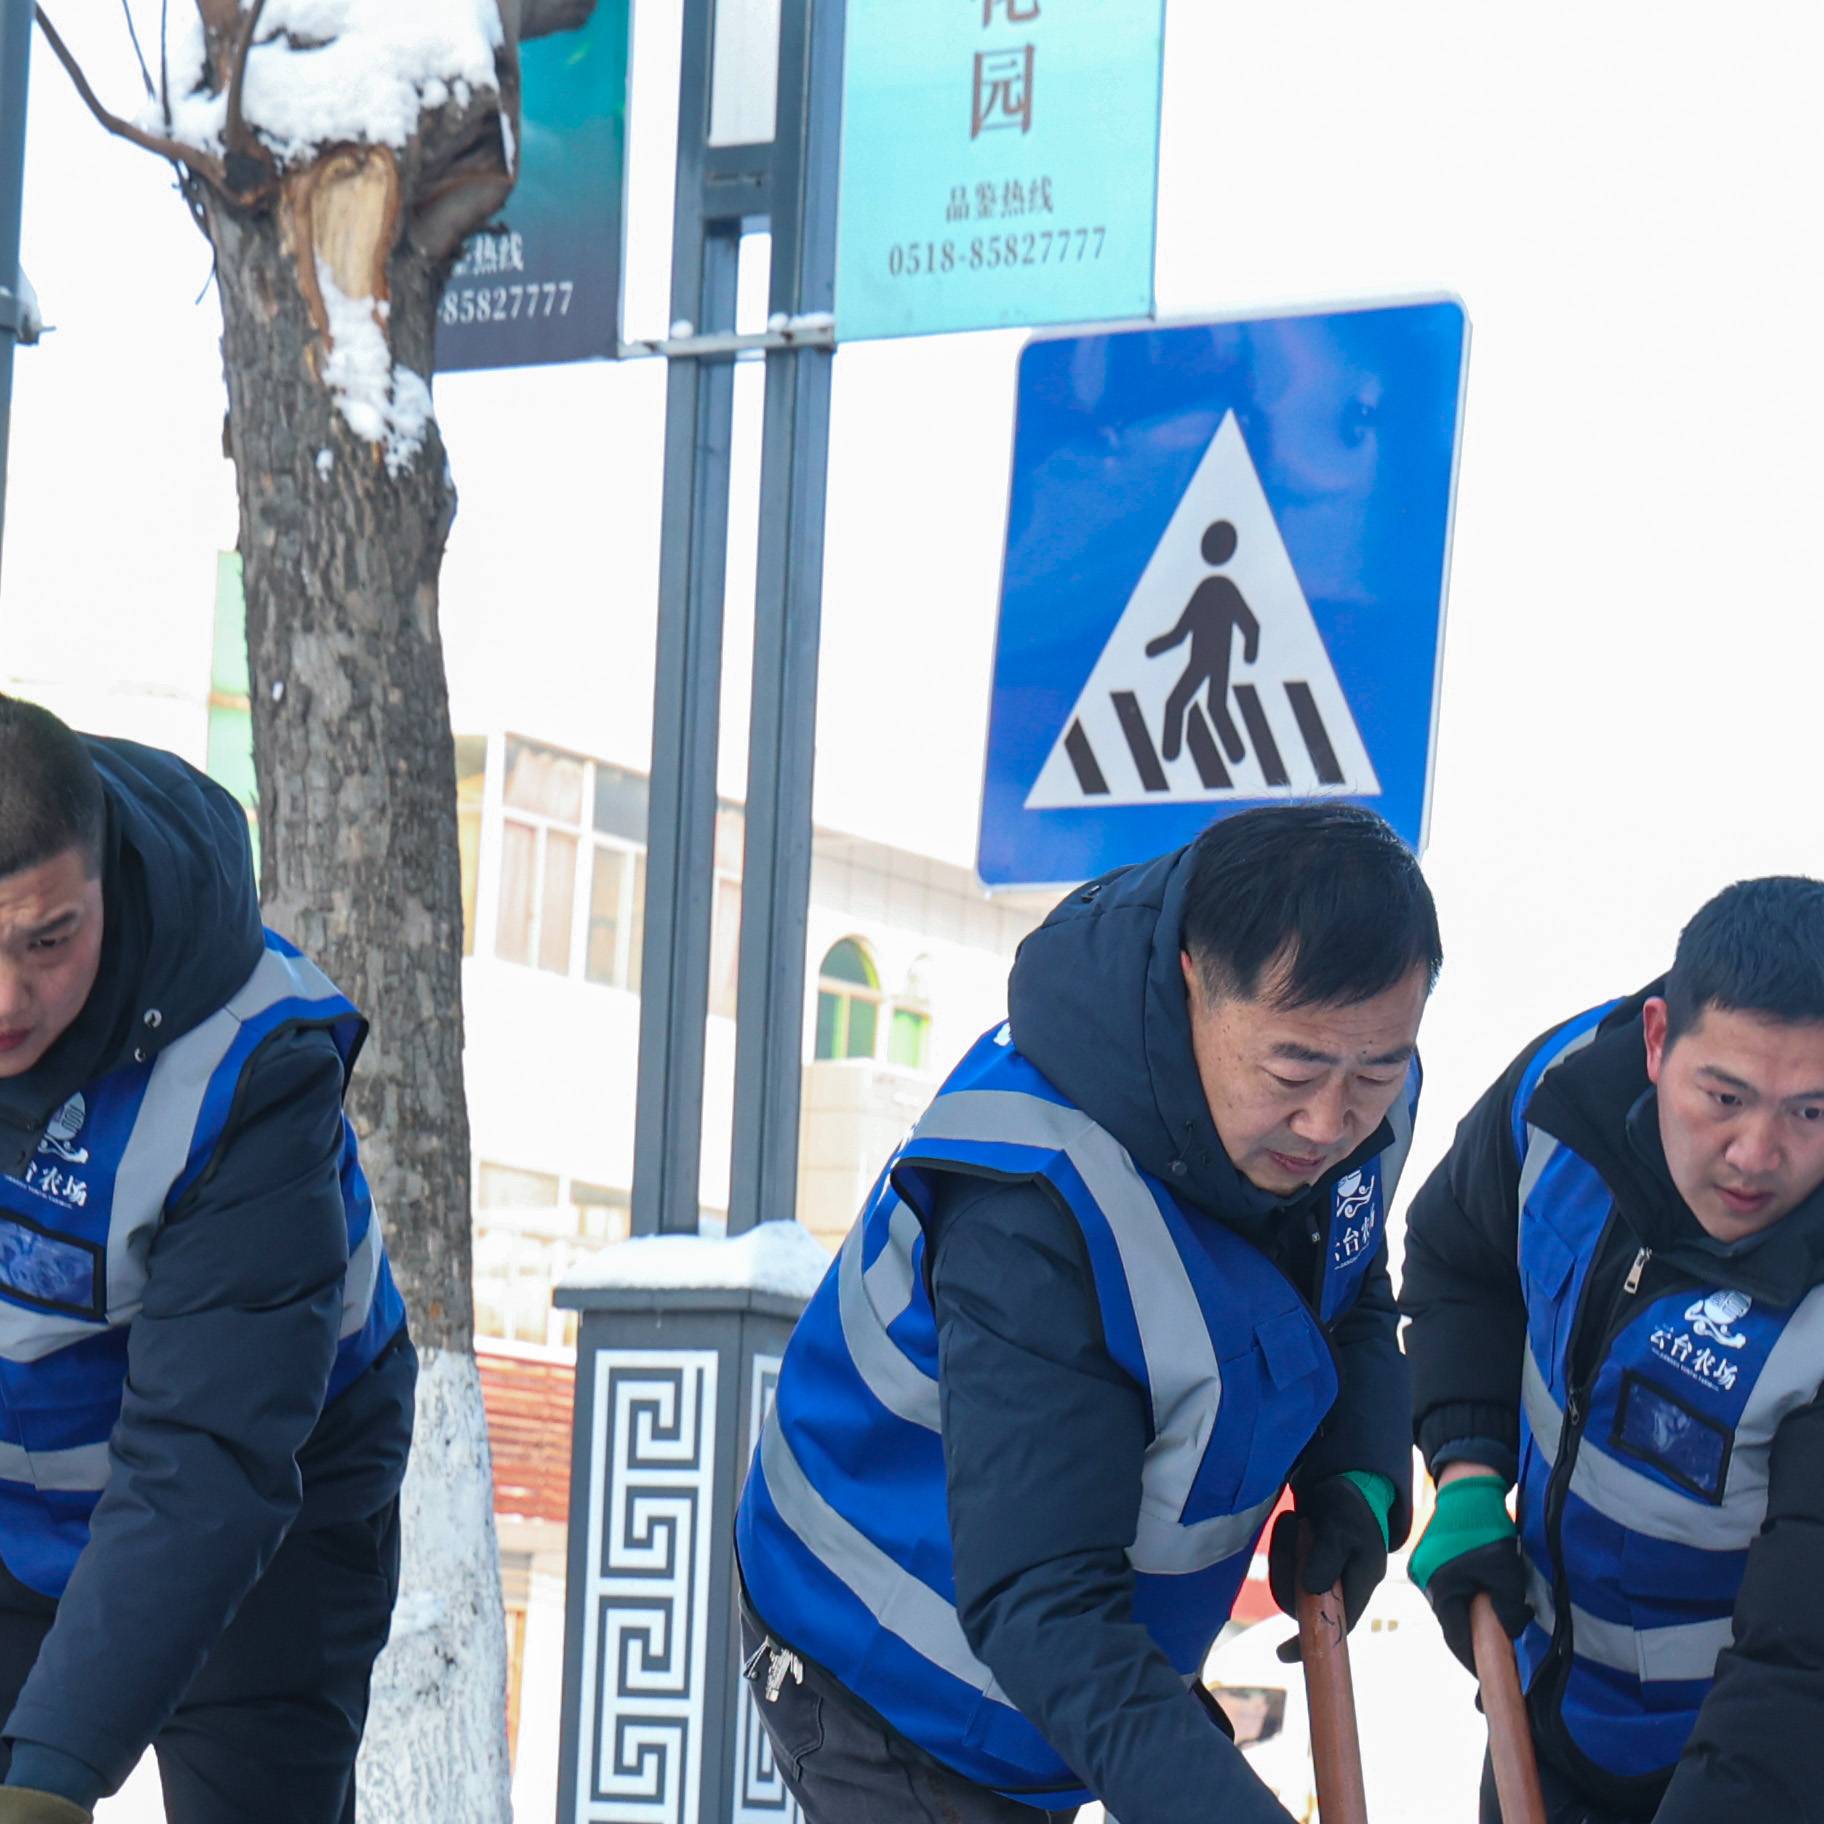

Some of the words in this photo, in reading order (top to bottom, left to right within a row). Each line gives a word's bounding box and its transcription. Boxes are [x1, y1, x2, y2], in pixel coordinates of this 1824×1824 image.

[945, 175, 1054, 222] 品鉴热线
[888, 226, 1107, 277] 0518-85827777
[1650, 1325, 1739, 1391] 云台农场
